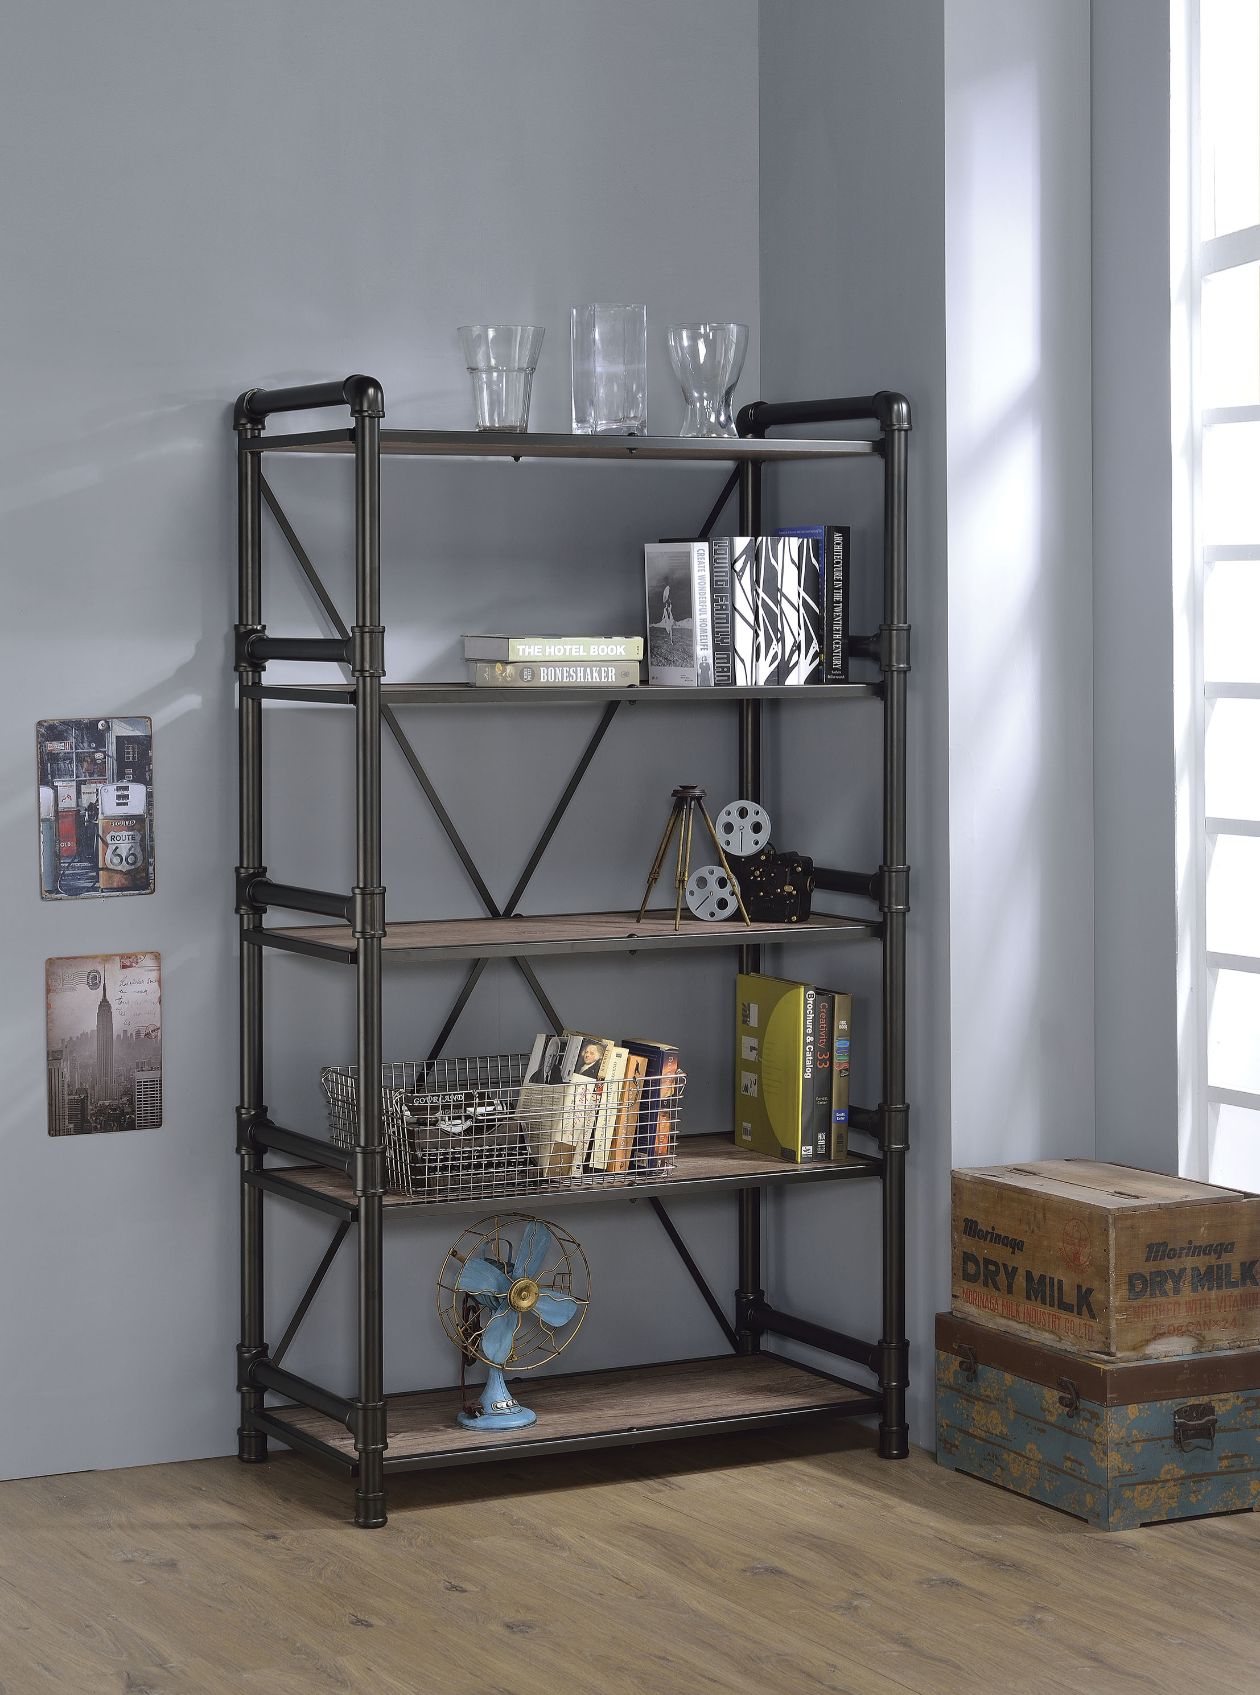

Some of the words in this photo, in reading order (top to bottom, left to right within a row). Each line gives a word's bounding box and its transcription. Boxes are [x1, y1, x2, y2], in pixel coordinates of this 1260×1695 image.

[696, 548, 706, 573] CREATE
[697, 574, 708, 617] WONDERFUL
[833, 589, 843, 601] THE
[699, 618, 709, 652] HOMELIFE
[713, 593, 731, 646] FAMILY
[832, 603, 843, 639] TWENTIETH
[517, 645, 542, 657] THE
[545, 644, 585, 657] HOTEL
[590, 644, 626, 656] BOOK
[832, 640, 842, 669] CENTURY
[540, 667, 616, 683] BONESHAKER
[714, 651, 732, 684] MAN
[110, 834, 136, 842] ROUTE
[110, 845, 138, 867] 66
[805, 990, 816, 1034] Brochure
[818, 1002, 828, 1049] Creativity
[804, 1044, 814, 1079] Catalog
[816, 1051, 830, 1069] 33
[962, 1217, 1025, 1255] Morinaga
[1145, 1240, 1236, 1263] Morinaga
[962, 1251, 1018, 1296] DRY
[1025, 1269, 1098, 1321] MILK
[1127, 1267, 1187, 1301] DRY
[1190, 1259, 1260, 1295] MILK
[1001, 1298, 1020, 1321] MILK
